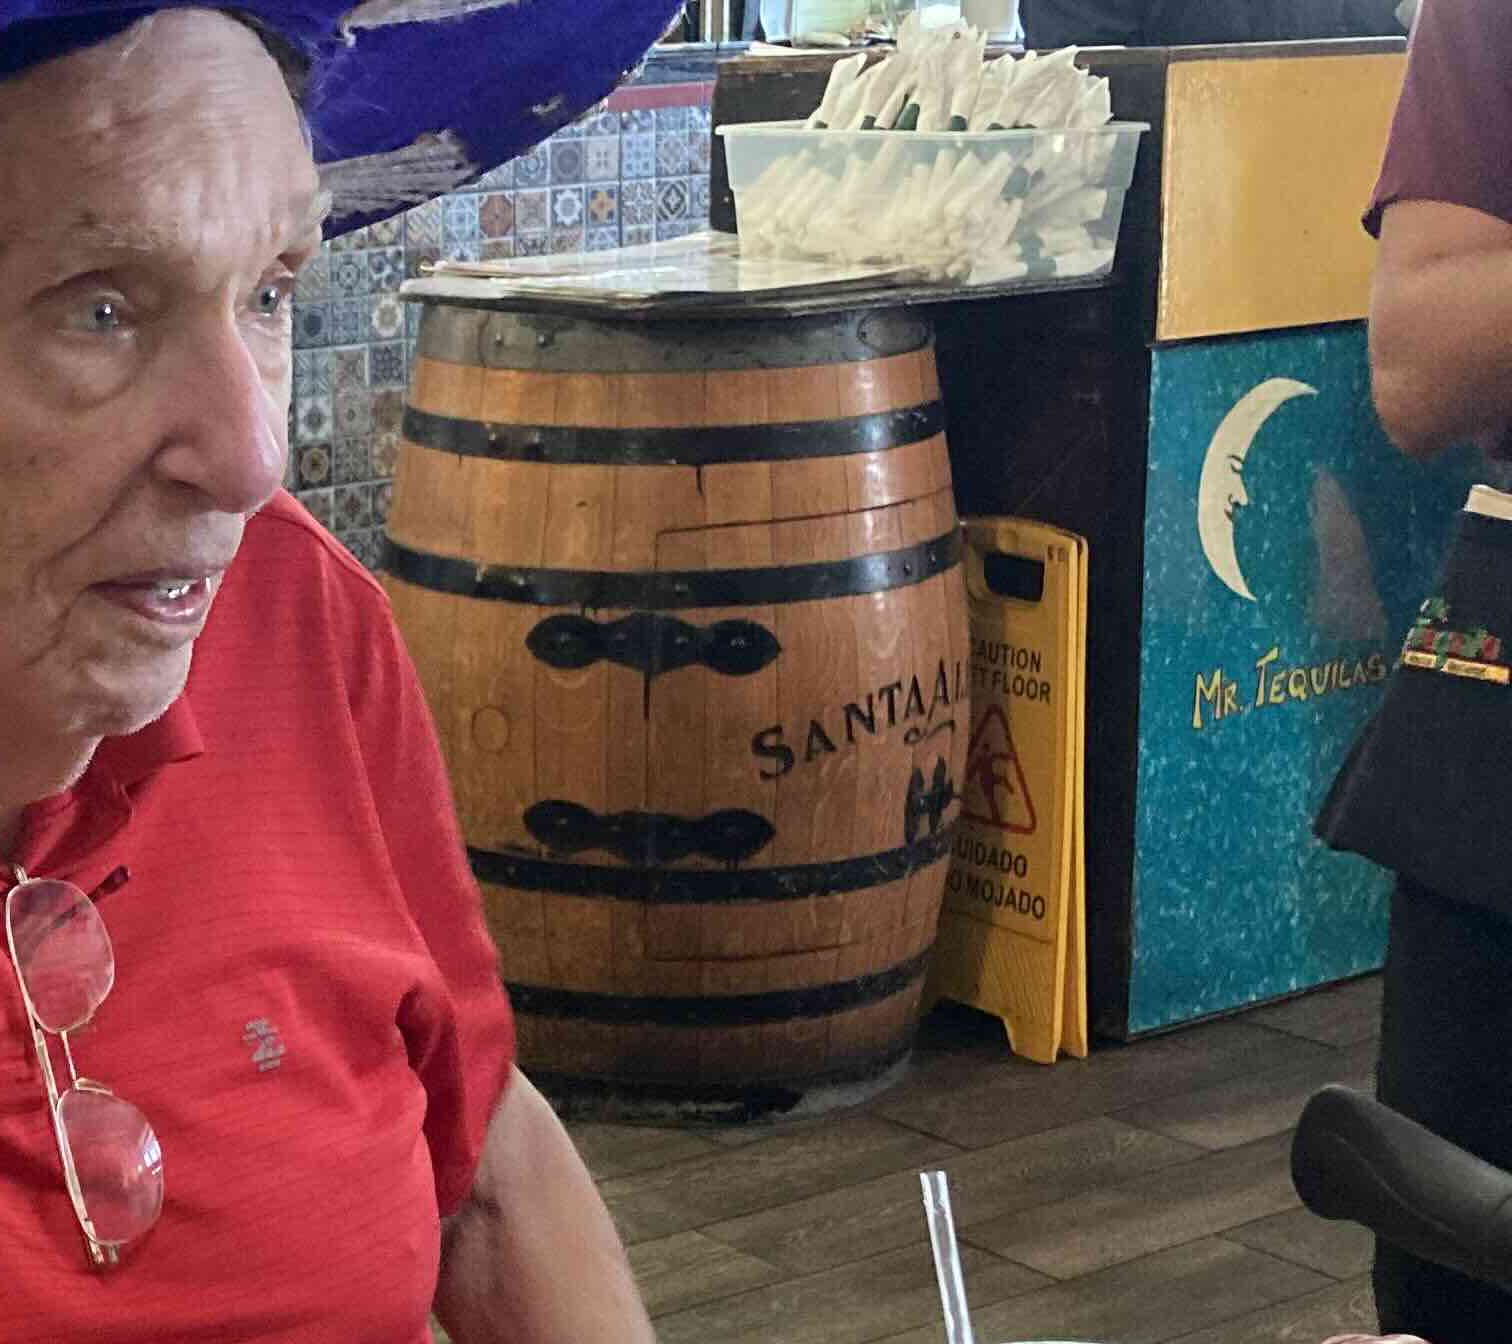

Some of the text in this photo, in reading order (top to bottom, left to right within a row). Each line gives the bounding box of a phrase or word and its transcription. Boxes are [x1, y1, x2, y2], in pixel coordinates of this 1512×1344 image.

[971, 639, 1042, 673] AUTION
[990, 669, 1051, 705] FLOOR
[951, 836, 1028, 878] UIDADO
[966, 873, 1046, 920] MOJADO
